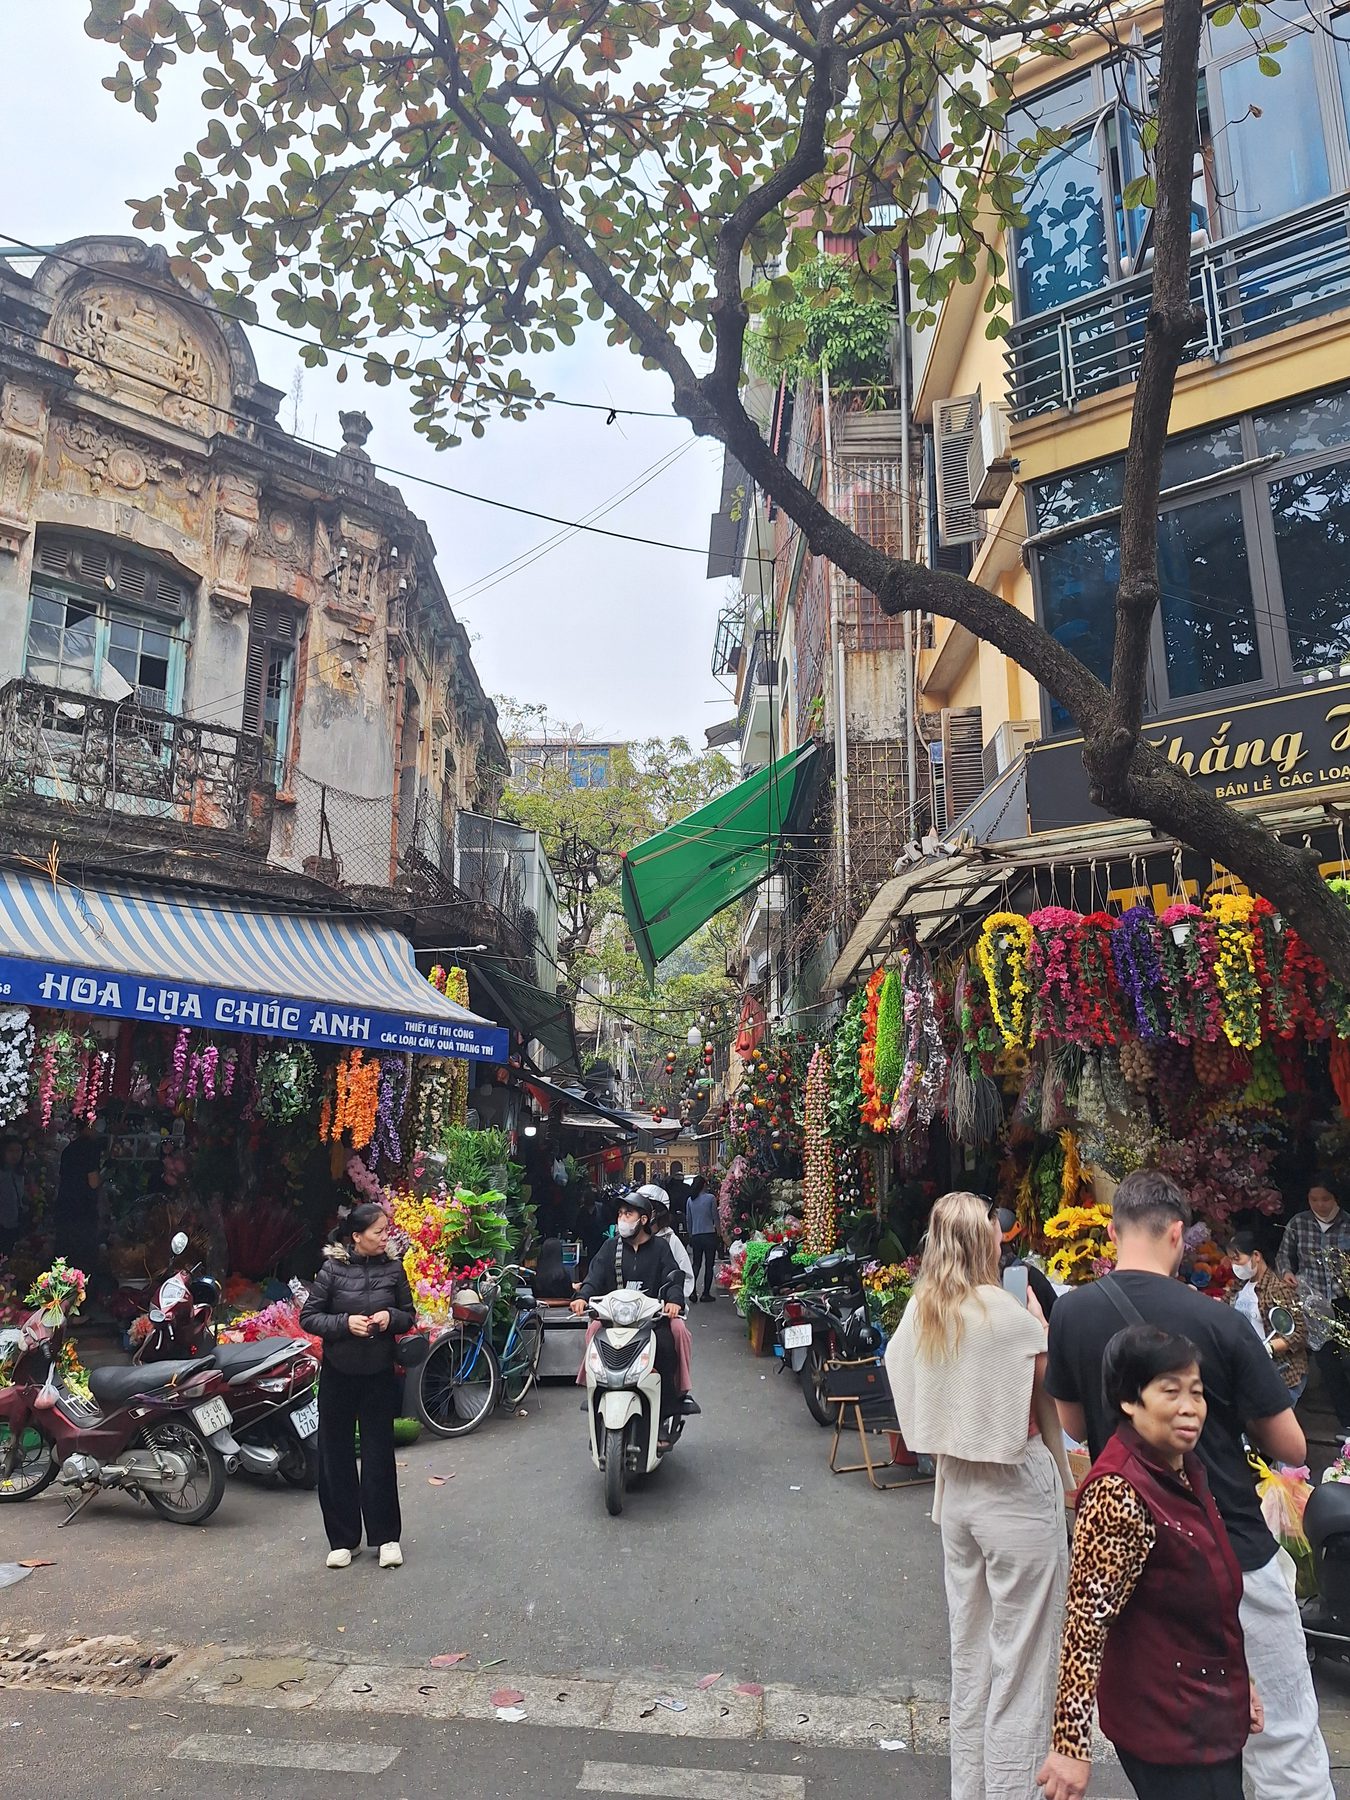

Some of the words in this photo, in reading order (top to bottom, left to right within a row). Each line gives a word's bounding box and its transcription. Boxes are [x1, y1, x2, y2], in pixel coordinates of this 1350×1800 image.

[1215, 782, 1248, 798] BÁN
[1253, 774, 1272, 792] LẺ
[1280, 770, 1314, 787] CÁC
[38, 972, 122, 1009] HOA
[135, 986, 202, 1021] LỤA
[215, 997, 301, 1031] CHÚC
[309, 1011, 371, 1040] ANH
[404, 1020, 426, 1033] THIẾT
[428, 1023, 439, 1035] KẾ
[439, 1026, 452, 1037] THI
[453, 1027, 474, 1040] CÔNG
[380, 1032, 397, 1043] CÁC
[399, 1035, 417, 1047] LOẠI
[418, 1036, 435, 1050] CÂY,
[456, 1042, 480, 1054] TRANG
[481, 1045, 494, 1056] TRÍ
